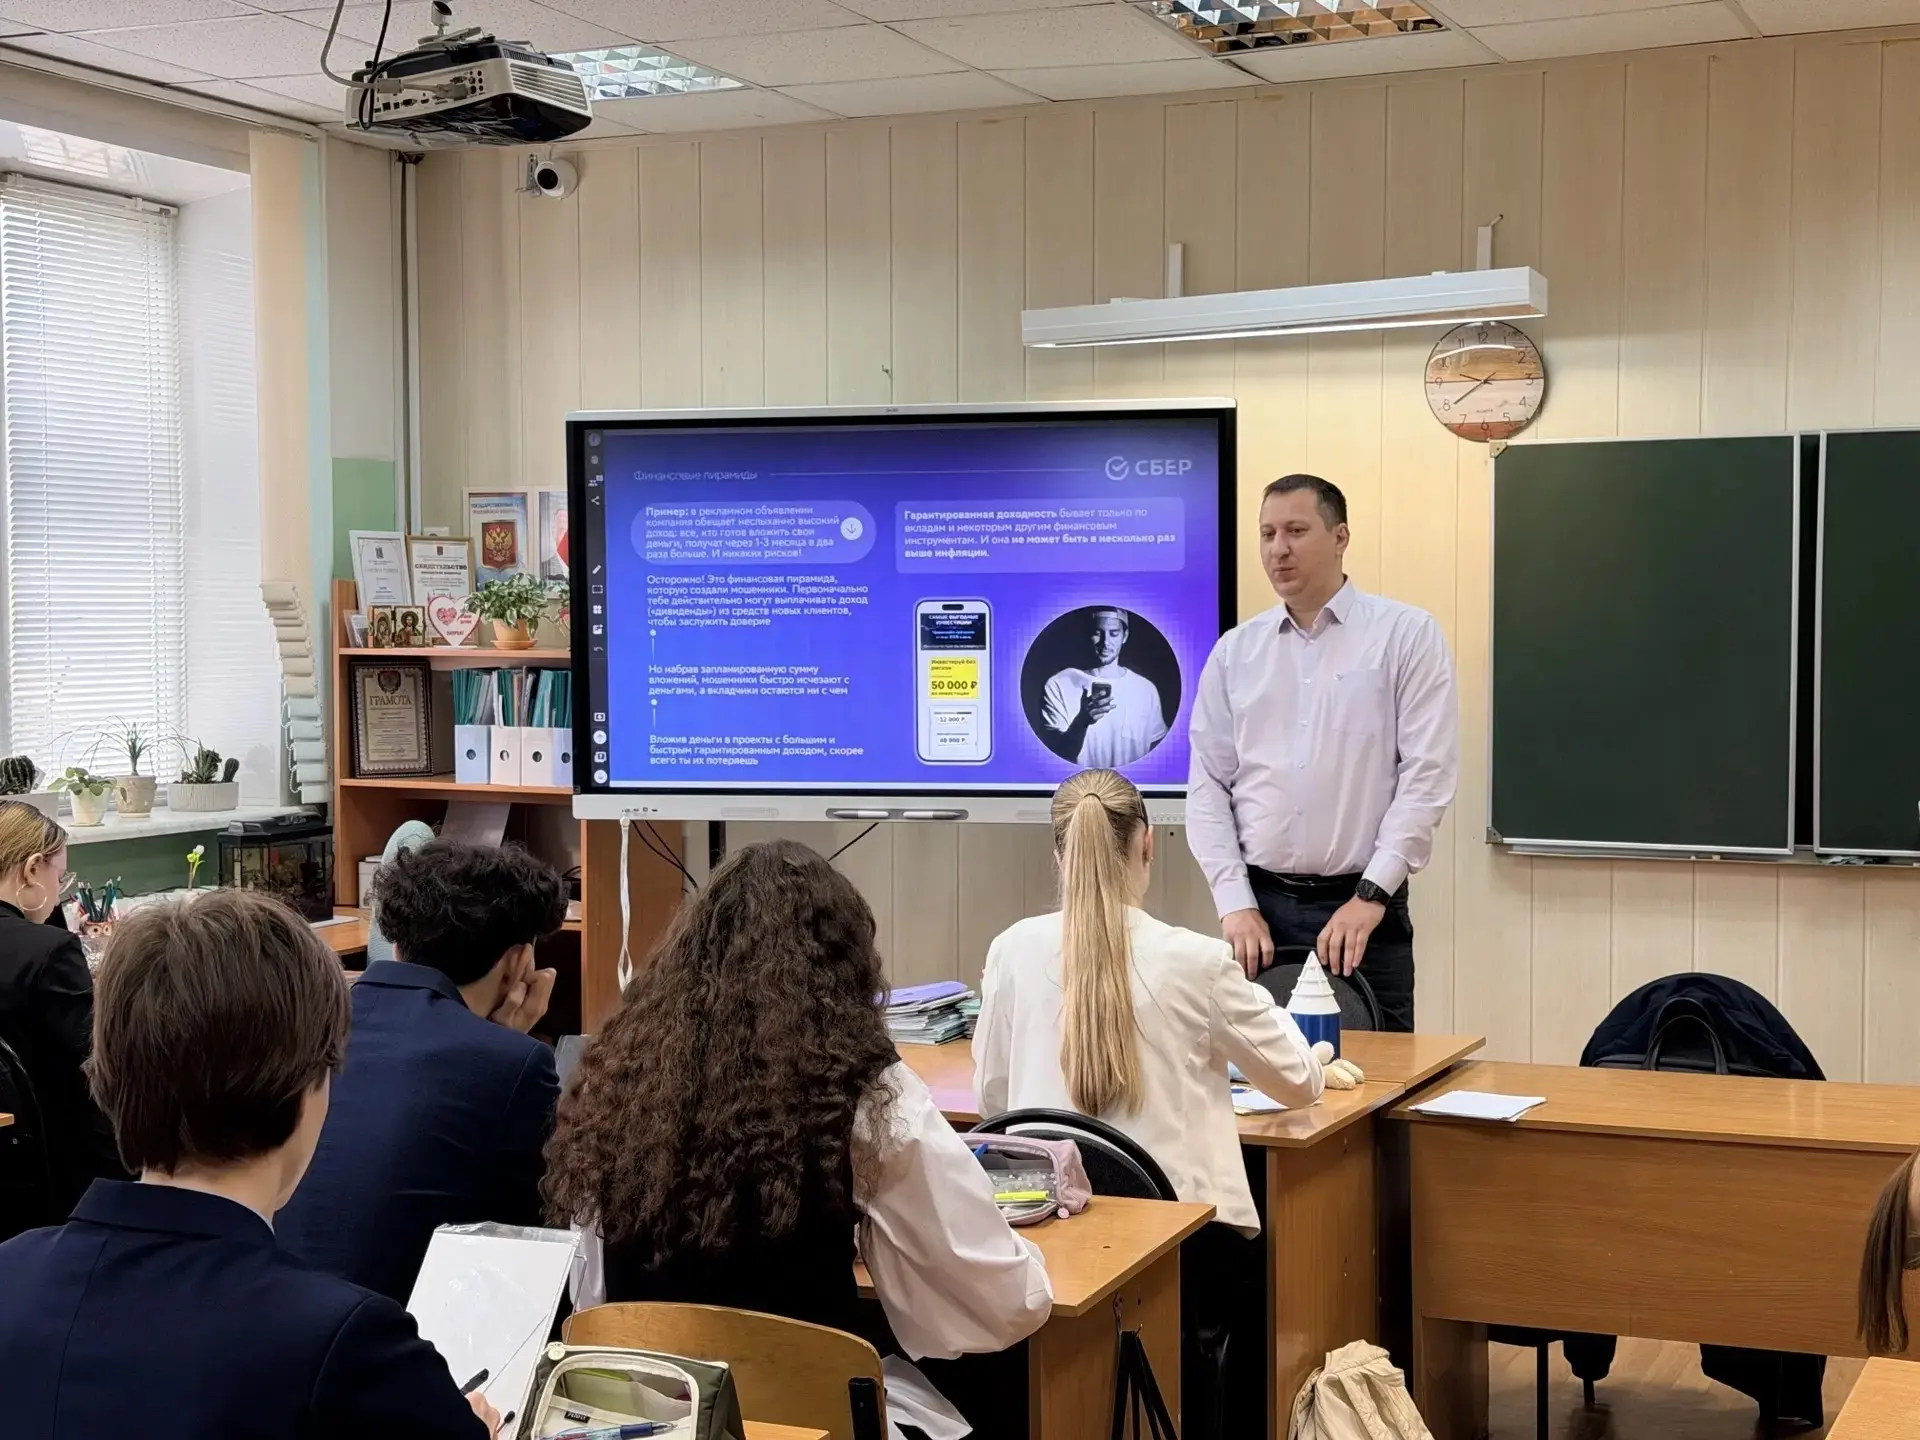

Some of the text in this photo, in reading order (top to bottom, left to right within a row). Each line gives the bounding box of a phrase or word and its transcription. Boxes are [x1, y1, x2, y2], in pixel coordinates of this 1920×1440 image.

[1478, 331, 1488, 344] 12
[1504, 336, 1506, 345] 1
[1441, 356, 1452, 368] 10
[1518, 351, 1526, 363] 2
[1435, 377, 1443, 388] 9
[1525, 373, 1533, 385] 3
[1443, 399, 1450, 411] 8
[1519, 396, 1526, 408] 4
[1459, 414, 1467, 428] 7
[1503, 413, 1511, 423] 5
[1481, 419, 1489, 430] 6
[1135, 460, 1192, 476] СБЕР
[634, 471, 757, 482] Финансовые пирамиды
[646, 506, 813, 518] Пример: в рекламном объявлении
[904, 508, 1147, 520] Гарантированная доходность бывает только по
[646, 516, 840, 527] компания обещает неслыханно высокий
[646, 530, 677, 538] доход:
[680, 529, 698, 538] все,
[701, 529, 717, 537] кто
[720, 529, 746, 537] готов
[749, 528, 790, 537] вложить
[905, 522, 1117, 533] вкладам и некоторым другим финансовым
[646, 540, 683, 549] деньги,
[685, 540, 723, 548] получат
[725, 539, 753, 547] через
[755, 538, 769, 547] 1-3
[772, 539, 805, 548] месяца
[817, 538, 834, 547] два
[905, 536, 978, 546] инструментам.
[981, 536, 988, 544] И
[992, 536, 1010, 544] она
[1012, 536, 1024, 544] не
[1027, 535, 1060, 544] может
[1063, 534, 1088, 543] быть
[1100, 534, 1154, 542] несколько
[1157, 534, 1175, 544] раз
[646, 549, 803, 560] раза больше. И никаких рисков!
[905, 548, 990, 559] выше инфляции.
[647, 575, 838, 585] Осторожно! Это финансовая пирамида,
[648, 585, 868, 595] которую создали мошенники. Первоначально
[648, 595, 868, 605] тебе действительно могут выплачивать доход
[732, 608, 769, 616] средств
[804, 607, 851, 616] клиентов,
[648, 618, 771, 627] чтобы заслужить доверие
[649, 664, 819, 675] Но набрав запланированную сумму
[649, 675, 699, 684] вложений,
[702, 676, 757, 684] мошенники
[760, 675, 794, 685] быстро
[797, 676, 841, 684] исчезают
[932, 681, 944, 689] 50
[947, 681, 967, 689] 000
[649, 687, 697, 696] деньгами,
[708, 687, 758, 695] вкладчики
[761, 687, 804, 695] остаются
[370, 695, 412, 705] ГРАМОТА
[650, 735, 687, 744] Вложив
[689, 736, 722, 745] деньги
[733, 736, 773, 745] проекты
[783, 735, 826, 744] большим
[650, 746, 864, 756] быстрым гарантированным доходом, скорее
[650, 757, 676, 765] всего
[706, 757, 758, 766] потеряешь
